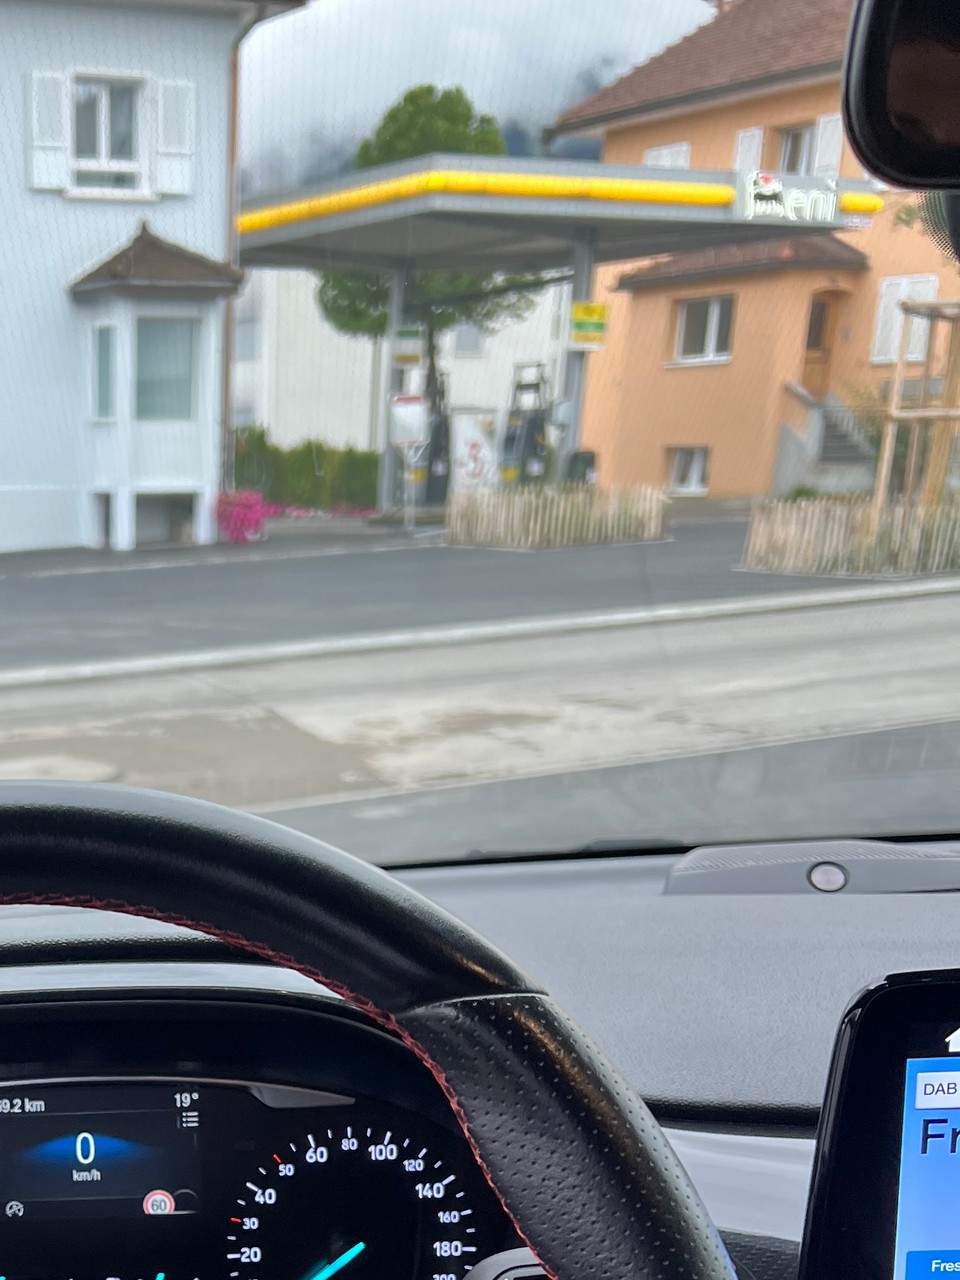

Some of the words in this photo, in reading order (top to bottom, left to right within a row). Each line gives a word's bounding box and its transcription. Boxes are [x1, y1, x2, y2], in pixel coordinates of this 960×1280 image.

[924, 1082, 957, 1096] DAB
[24, 1098, 45, 1113] km
[75, 1131, 95, 1164] 0
[341, 1137, 358, 1151] 80
[305, 1146, 328, 1163] 60
[368, 1143, 398, 1161] 100
[278, 1163, 295, 1176] 50
[402, 1158, 425, 1172] 120
[72, 1169, 101, 1182] km/h
[254, 1188, 276, 1204] 40
[415, 1182, 445, 1199] 140
[151, 1199, 167, 1212] 60
[242, 1217, 259, 1230] 30
[438, 1210, 460, 1223] 160
[240, 1246, 262, 1263] 20
[433, 1240, 462, 1257] 180
